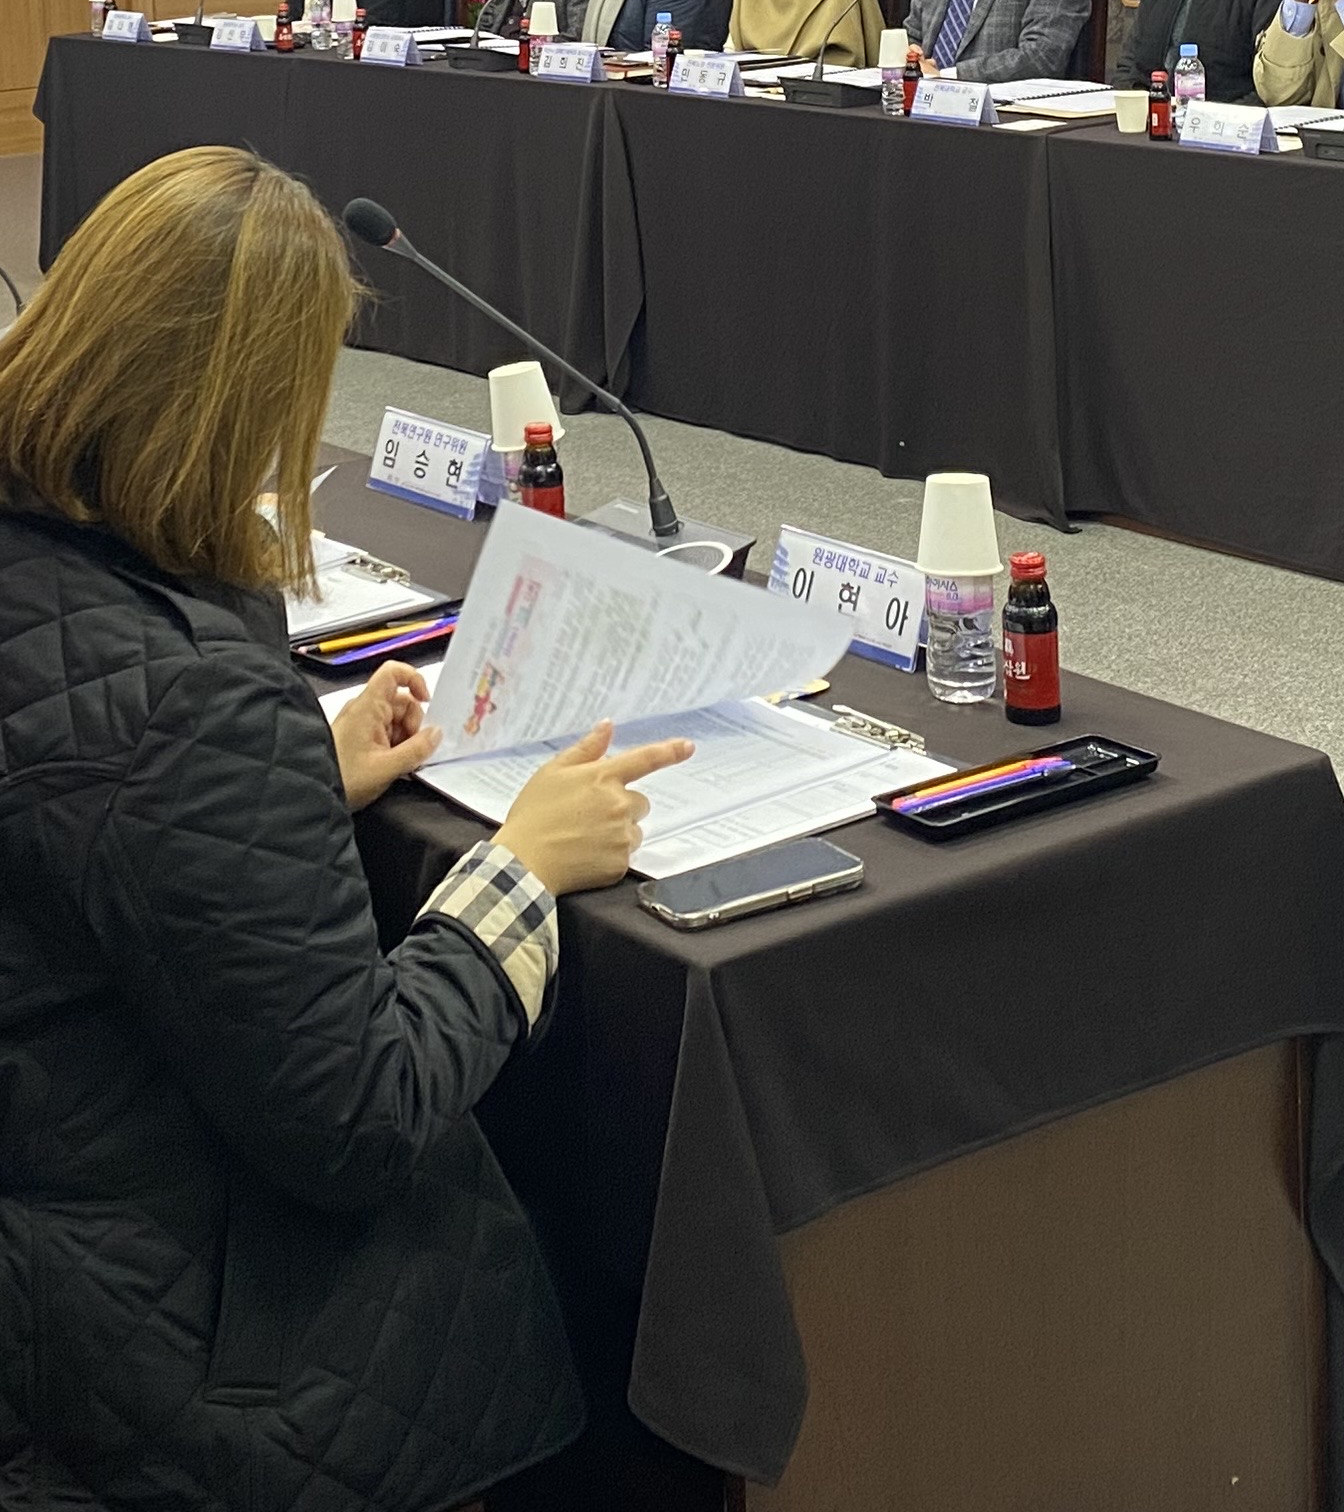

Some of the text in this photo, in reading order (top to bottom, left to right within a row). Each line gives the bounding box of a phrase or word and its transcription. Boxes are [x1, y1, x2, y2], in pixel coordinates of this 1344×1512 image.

[391, 419, 469, 455] 전북연구원 연구위원
[812, 547, 899, 588] 원광대학교 교수
